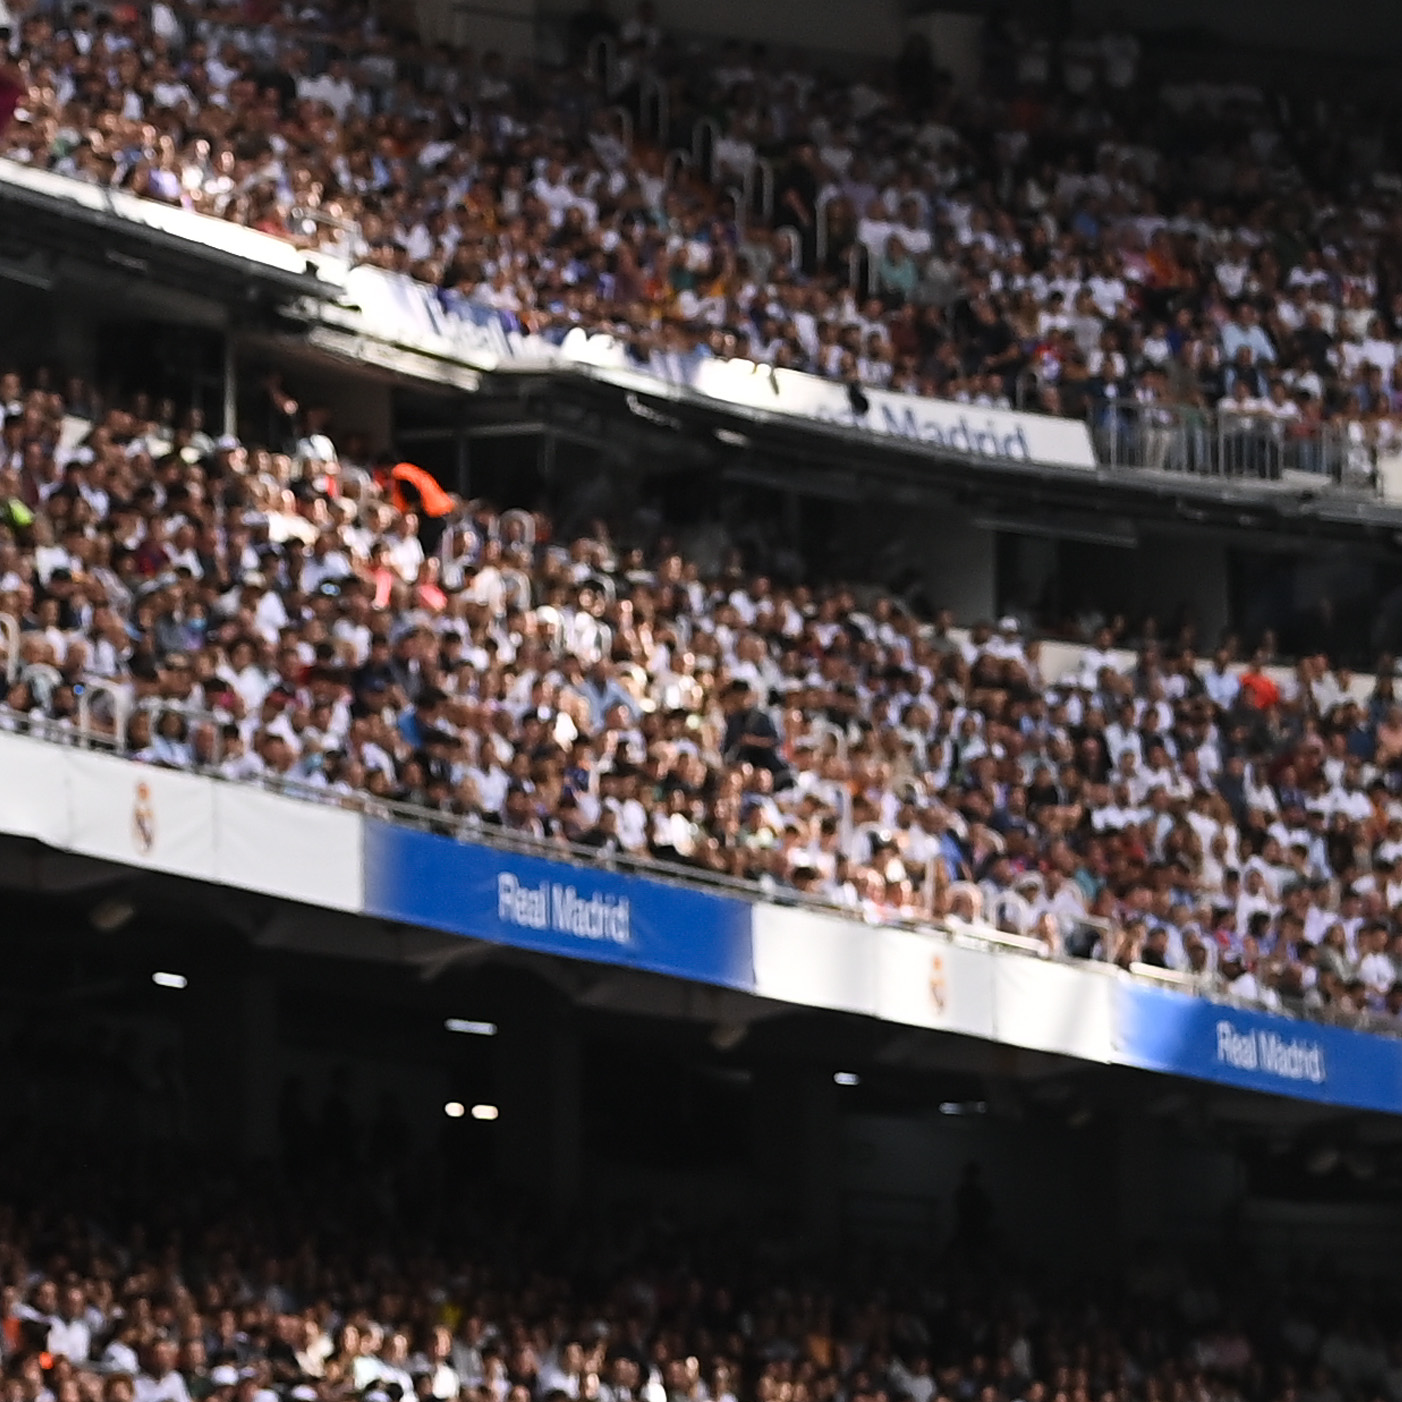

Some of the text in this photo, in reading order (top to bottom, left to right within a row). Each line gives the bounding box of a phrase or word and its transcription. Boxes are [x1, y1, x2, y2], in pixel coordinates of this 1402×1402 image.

[498, 872, 631, 944] Real Madrid
[1216, 1020, 1326, 1084] Real Madrid
